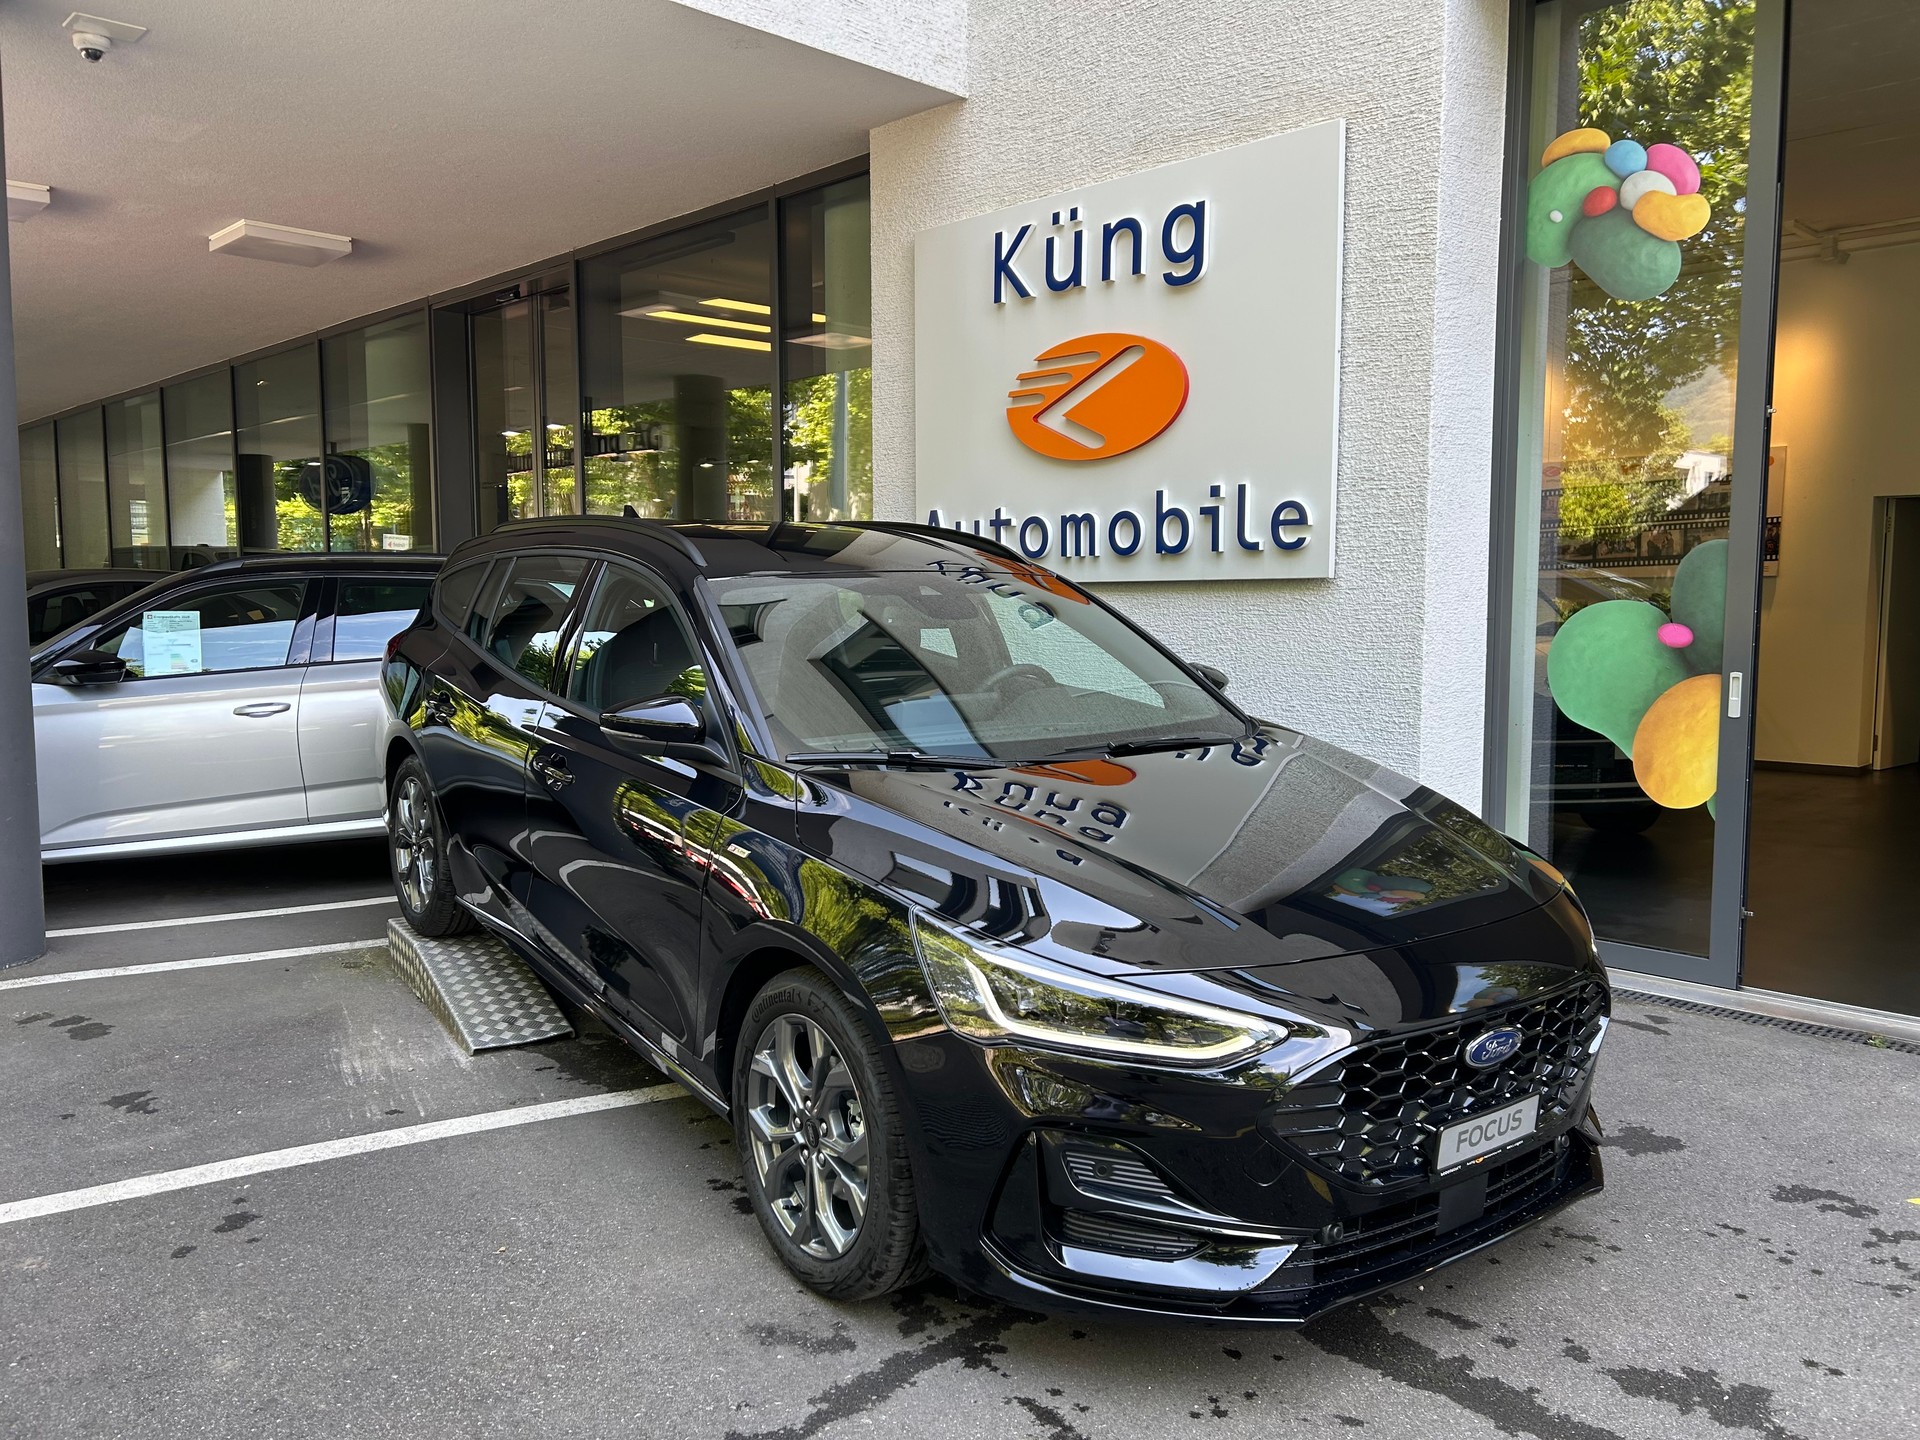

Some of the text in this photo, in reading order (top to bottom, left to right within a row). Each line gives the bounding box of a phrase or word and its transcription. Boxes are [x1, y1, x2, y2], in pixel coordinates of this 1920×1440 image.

[993, 200, 1209, 304] Küng
[1481, 1037, 1513, 1060] Ford
[1455, 1108, 1523, 1153] FOCUS
